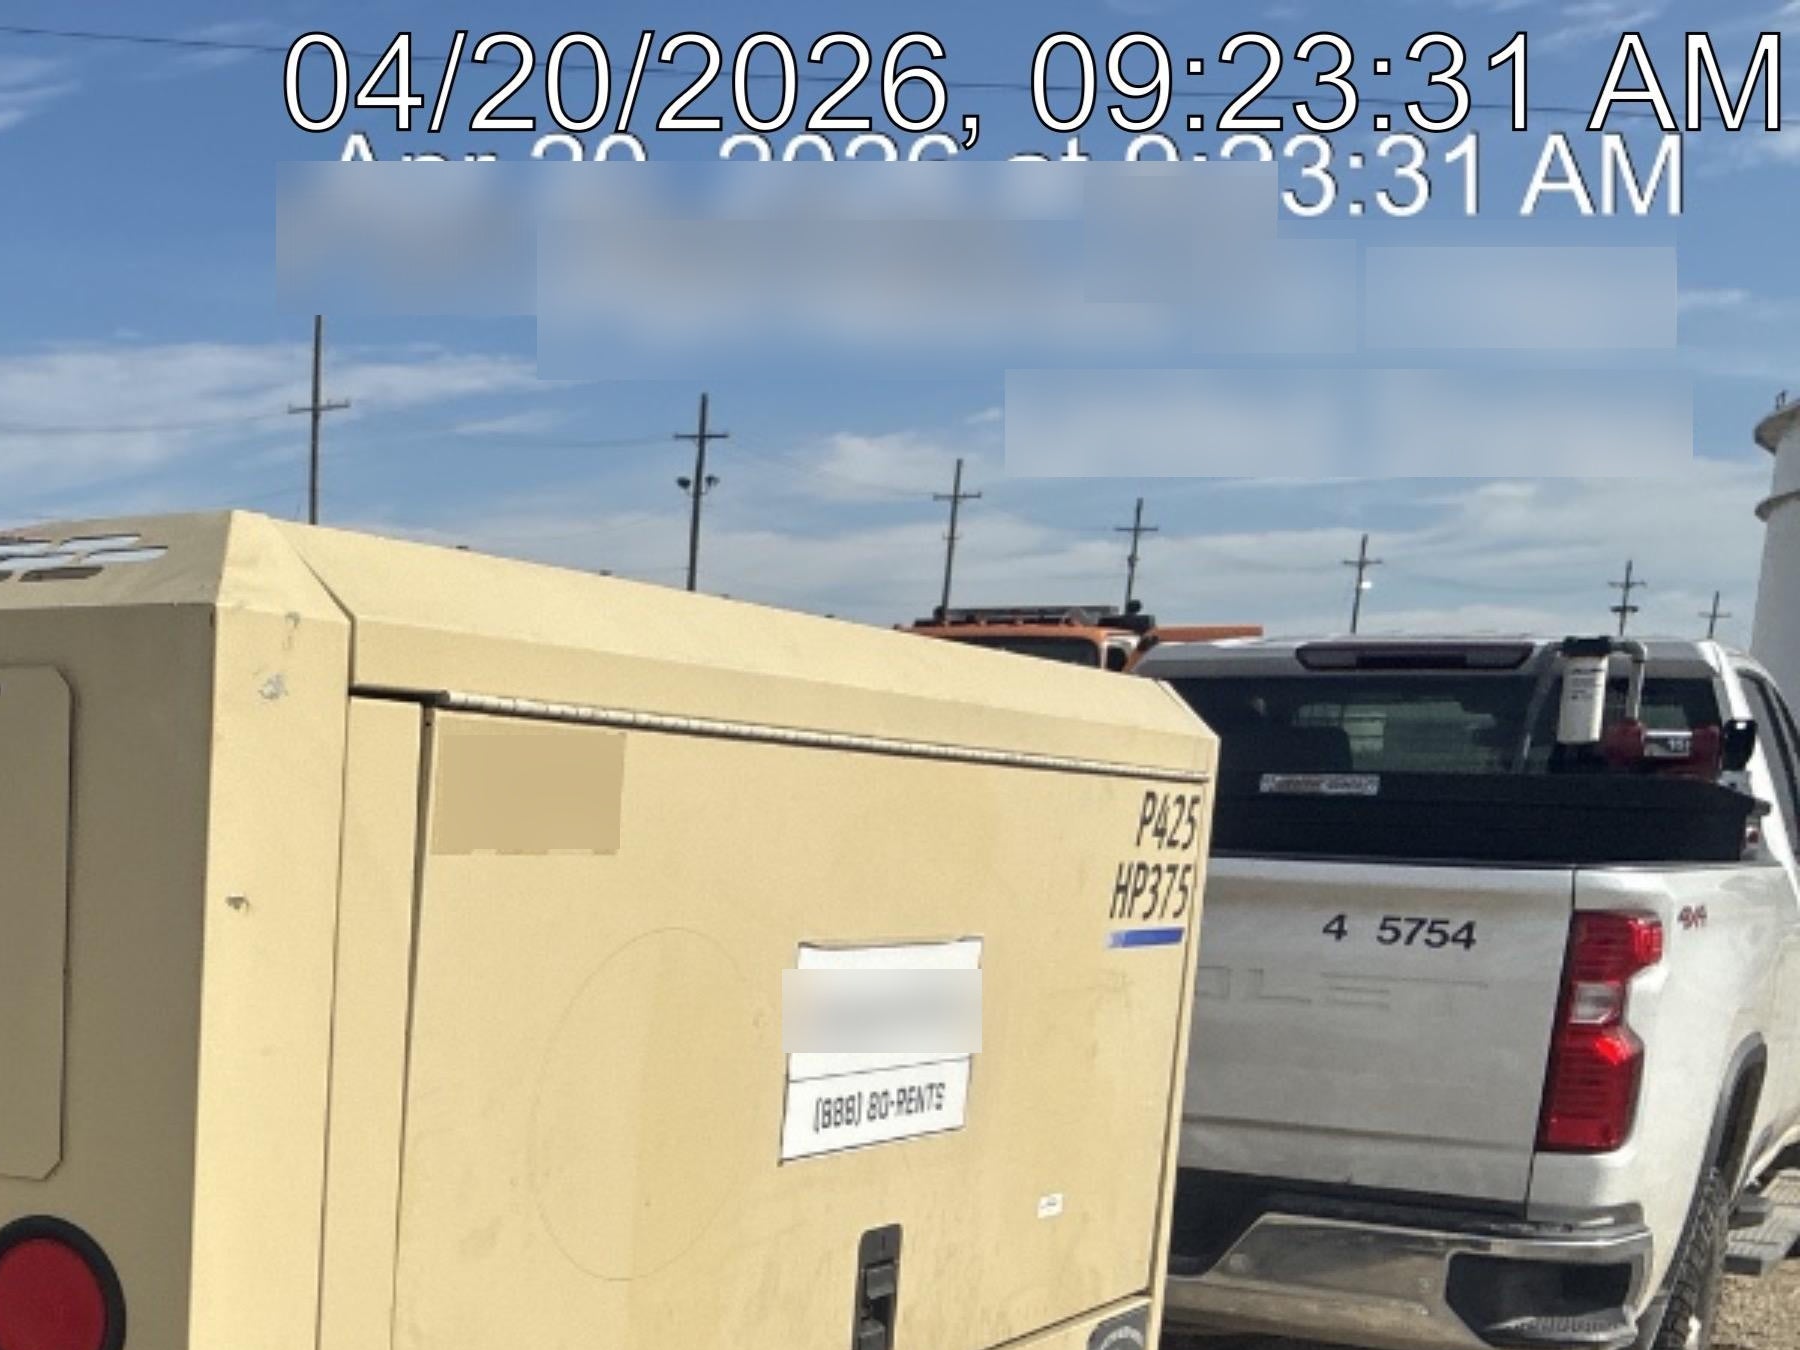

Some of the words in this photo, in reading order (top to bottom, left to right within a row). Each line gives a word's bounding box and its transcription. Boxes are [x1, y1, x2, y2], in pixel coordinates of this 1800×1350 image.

[1135, 790, 1201, 851] P425
[1109, 860, 1193, 921] HP375
[1321, 913, 1348, 941] 4
[1376, 914, 1477, 951] 5754
[812, 1090, 862, 1134] (888)
[867, 1082, 946, 1122] 80-RENTS
